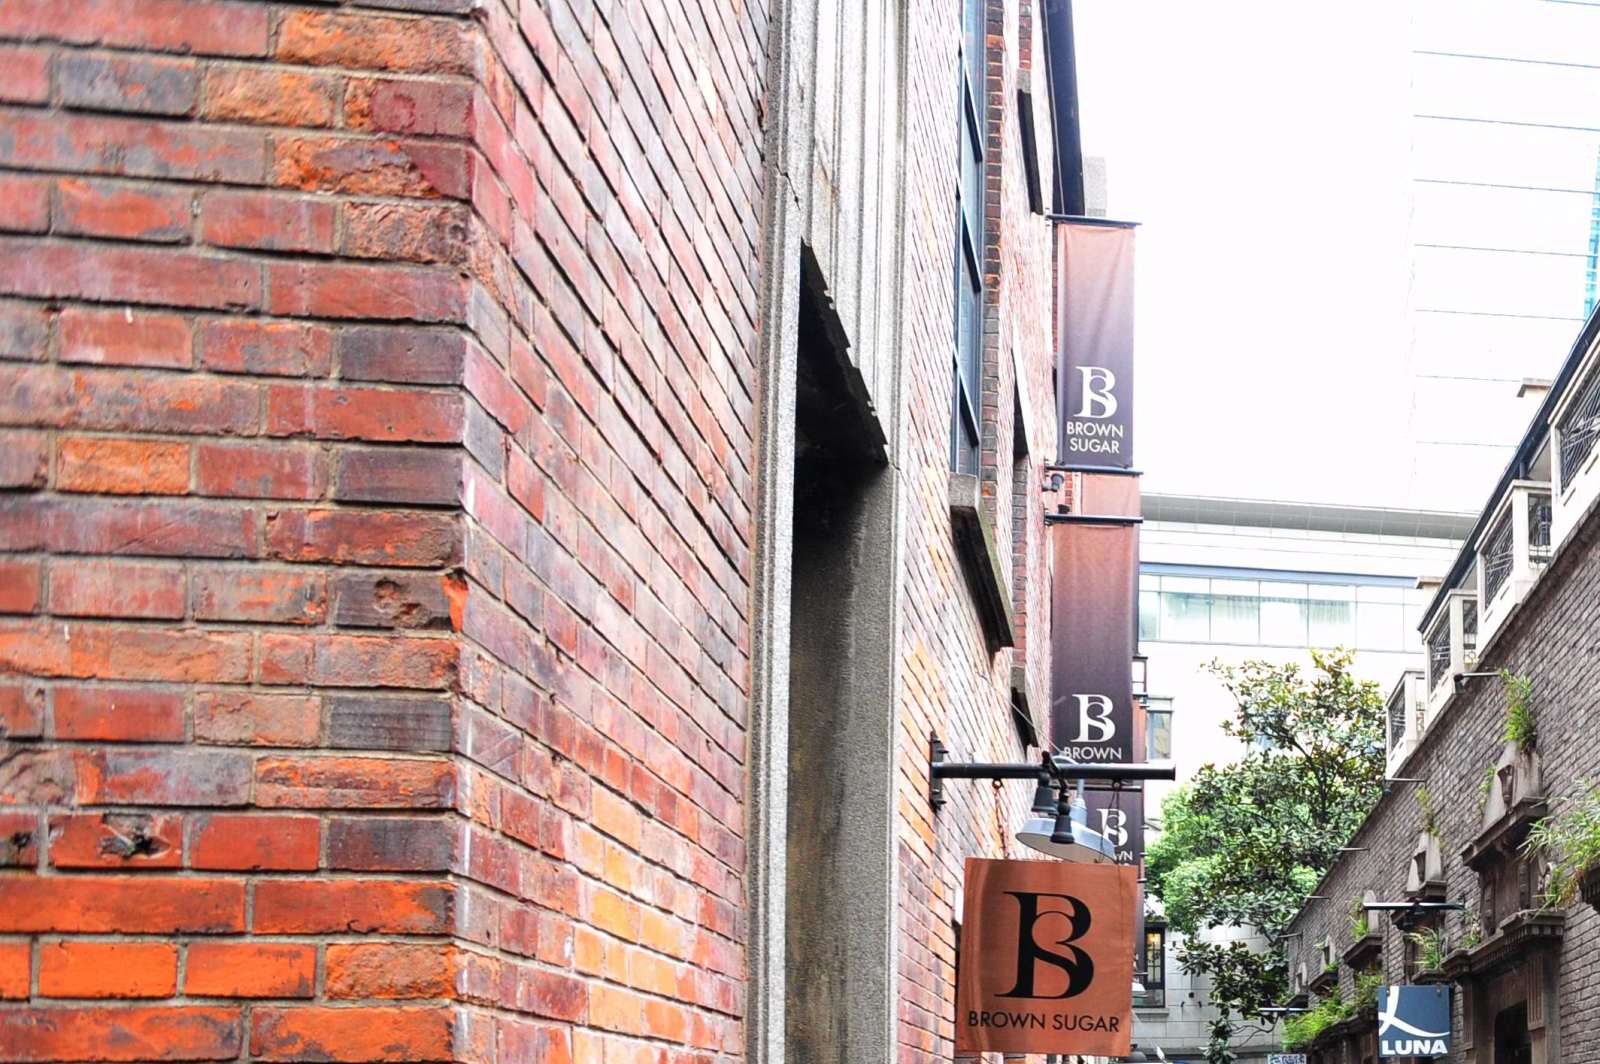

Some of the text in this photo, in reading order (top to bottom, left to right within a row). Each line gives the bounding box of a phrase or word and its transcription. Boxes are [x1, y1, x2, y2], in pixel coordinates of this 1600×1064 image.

[1066, 421, 1123, 438] BROWN
[1069, 437, 1120, 454] SUGAR
[1063, 746, 1122, 760] BROWN
[968, 1010, 1120, 1033] BROWN SUGAR
[1381, 1039, 1448, 1055] LUNA
